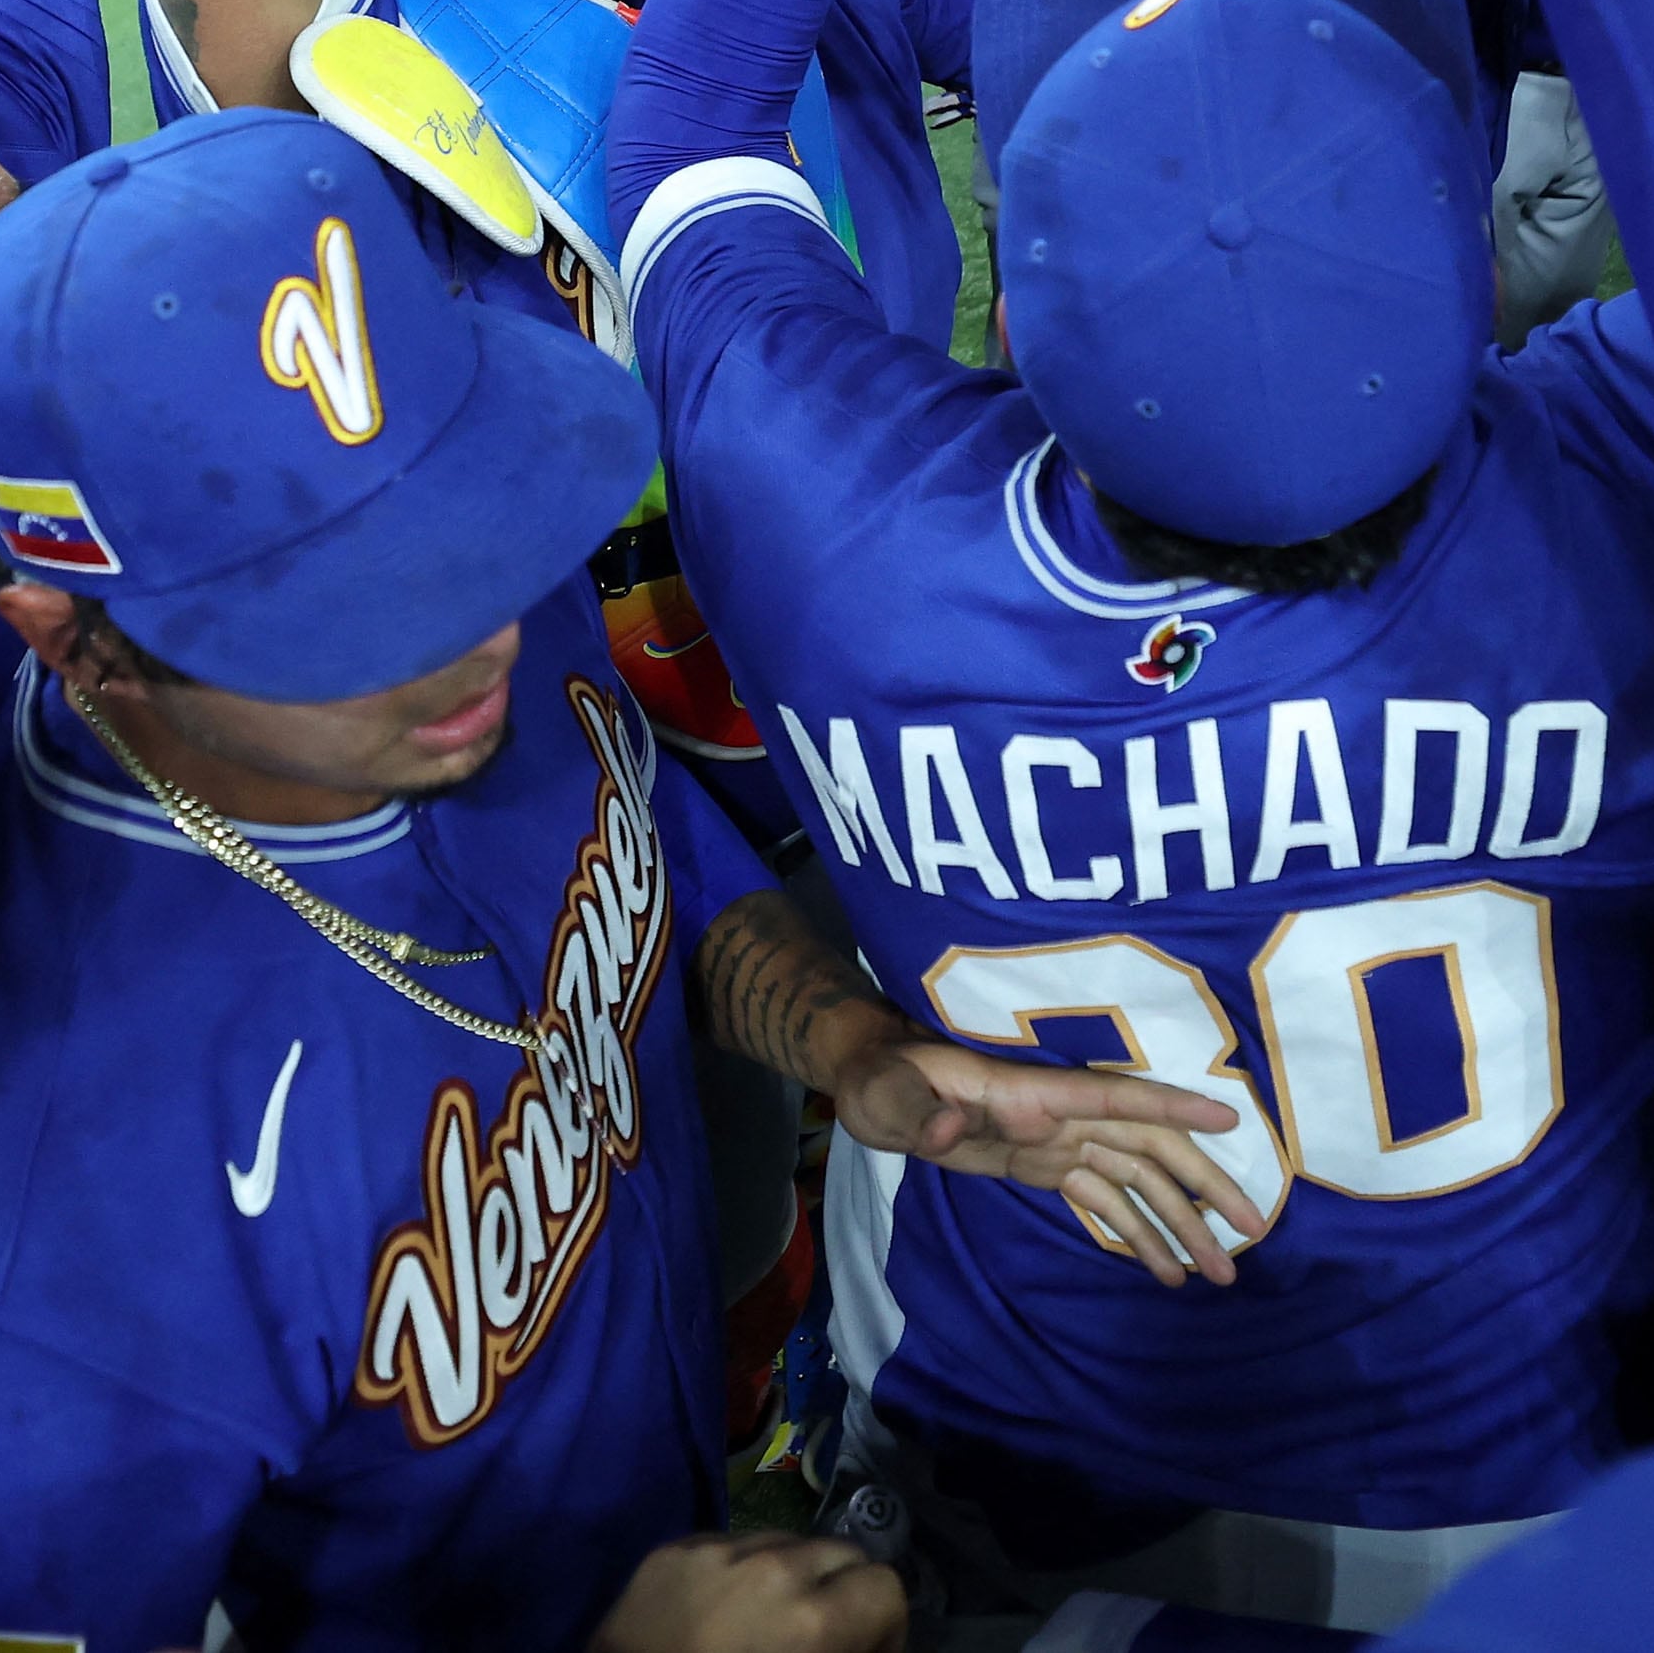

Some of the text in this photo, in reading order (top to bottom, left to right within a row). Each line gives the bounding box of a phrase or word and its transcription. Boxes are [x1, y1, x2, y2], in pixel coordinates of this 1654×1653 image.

[260, 215, 384, 447] V
[776, 697, 1608, 906] MACHADO
[920, 879, 1567, 1272] 30
